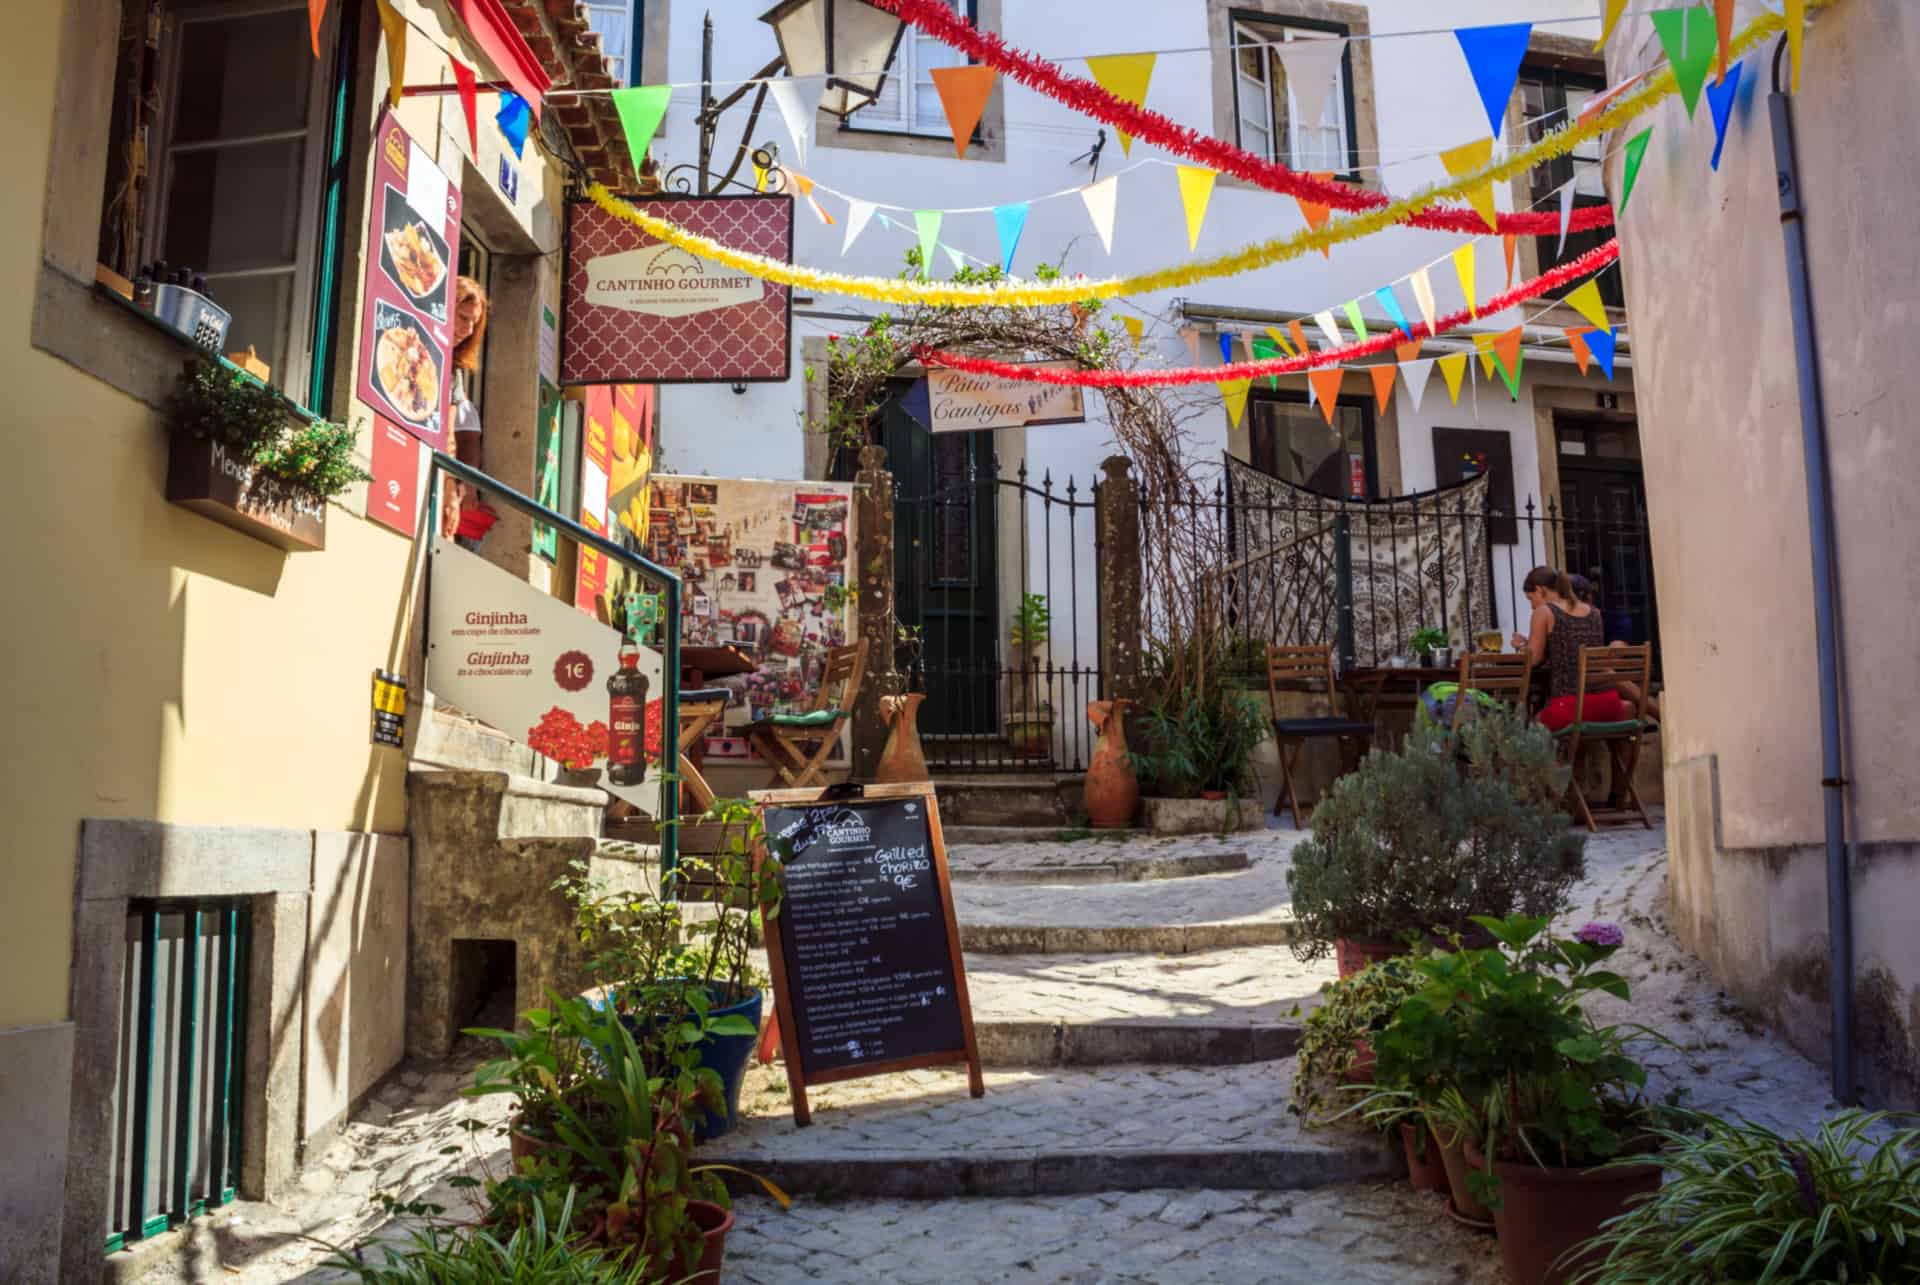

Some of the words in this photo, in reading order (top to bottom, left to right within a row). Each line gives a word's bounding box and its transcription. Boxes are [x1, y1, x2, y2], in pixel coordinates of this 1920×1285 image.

[596, 278, 675, 291] CANTINHO
[678, 277, 753, 290] GOURMET
[934, 399, 1023, 424] Cantigas
[465, 612, 528, 627] Ginjinha
[467, 651, 530, 667] Ginjinha
[474, 668, 515, 676] chocolate
[516, 669, 532, 677] cup
[564, 663, 585, 679] 1€
[827, 826, 870, 837] CANTINHO
[829, 834, 870, 844] GOURMET
[894, 874, 919, 892] 9€
